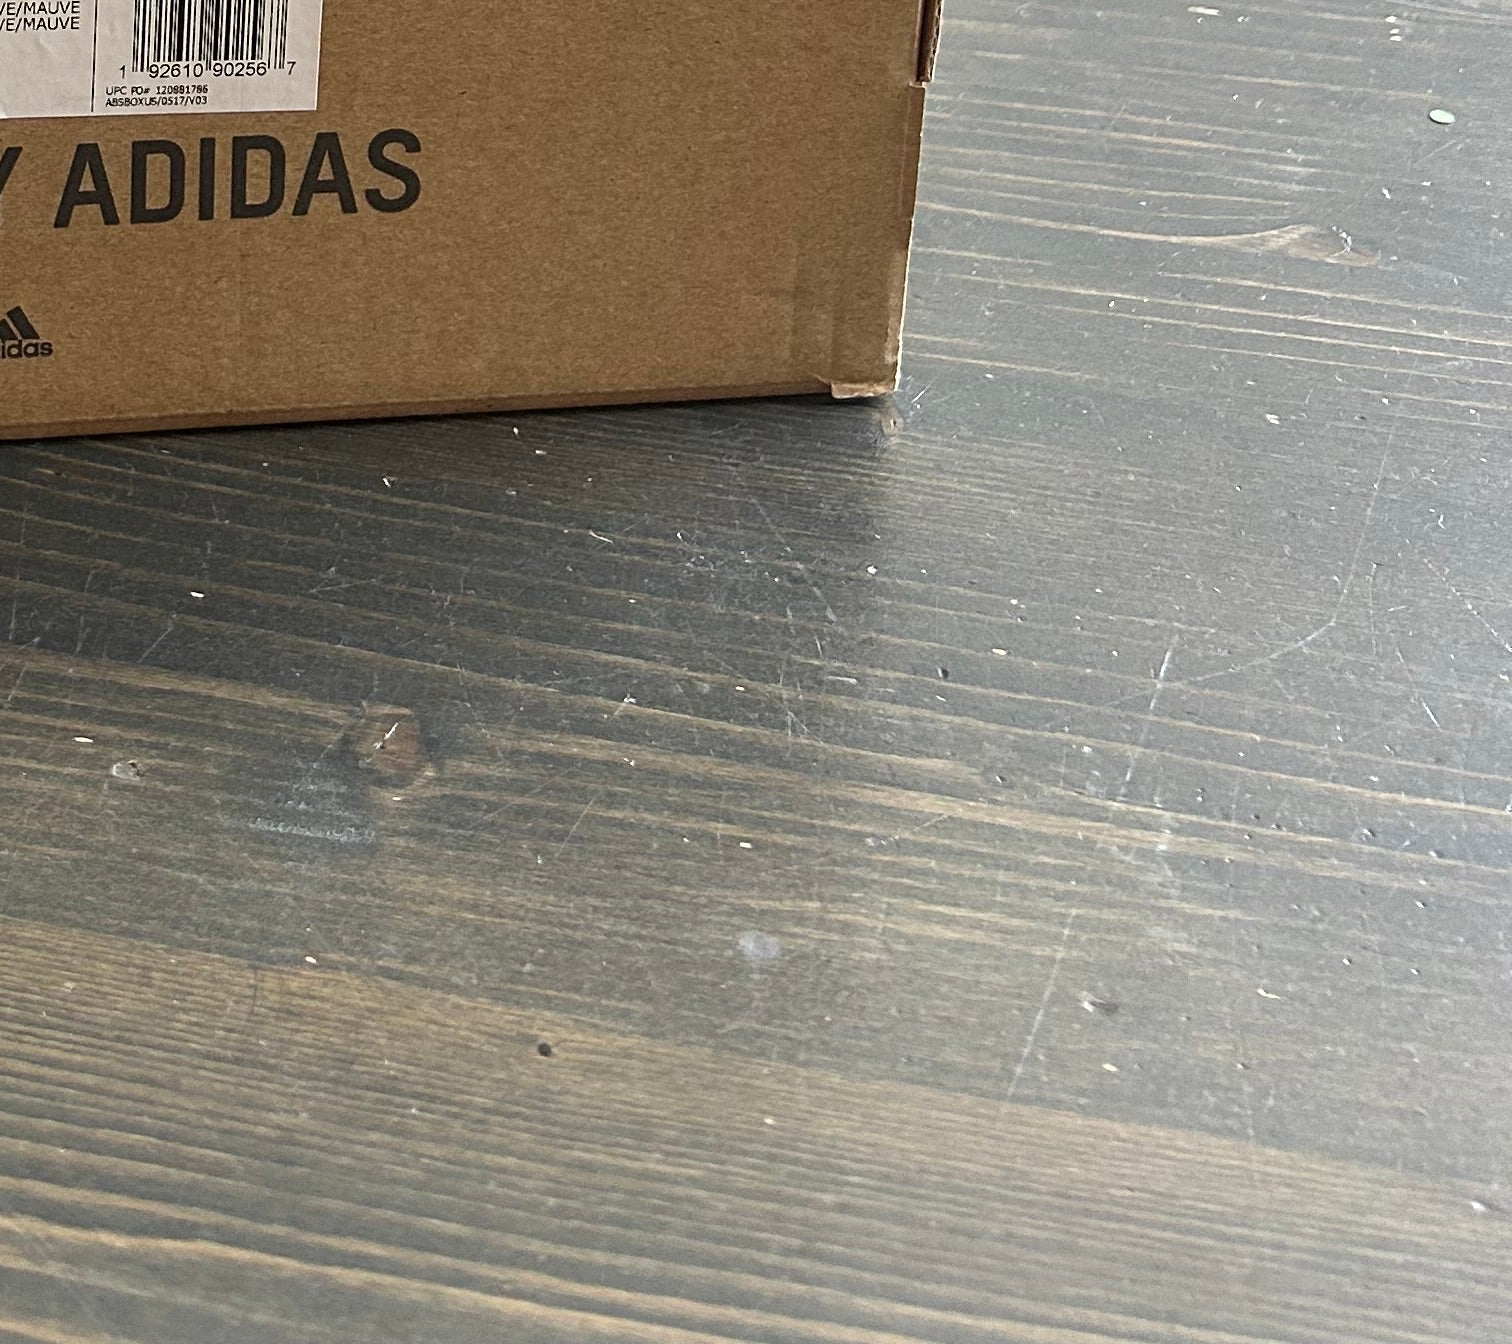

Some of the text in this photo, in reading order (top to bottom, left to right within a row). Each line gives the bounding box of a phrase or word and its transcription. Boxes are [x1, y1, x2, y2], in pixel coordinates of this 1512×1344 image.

[119, 61, 297, 79] 1 92610 90256 7
[105, 86, 128, 96] UPC
[53, 128, 423, 229] ADIDAS
